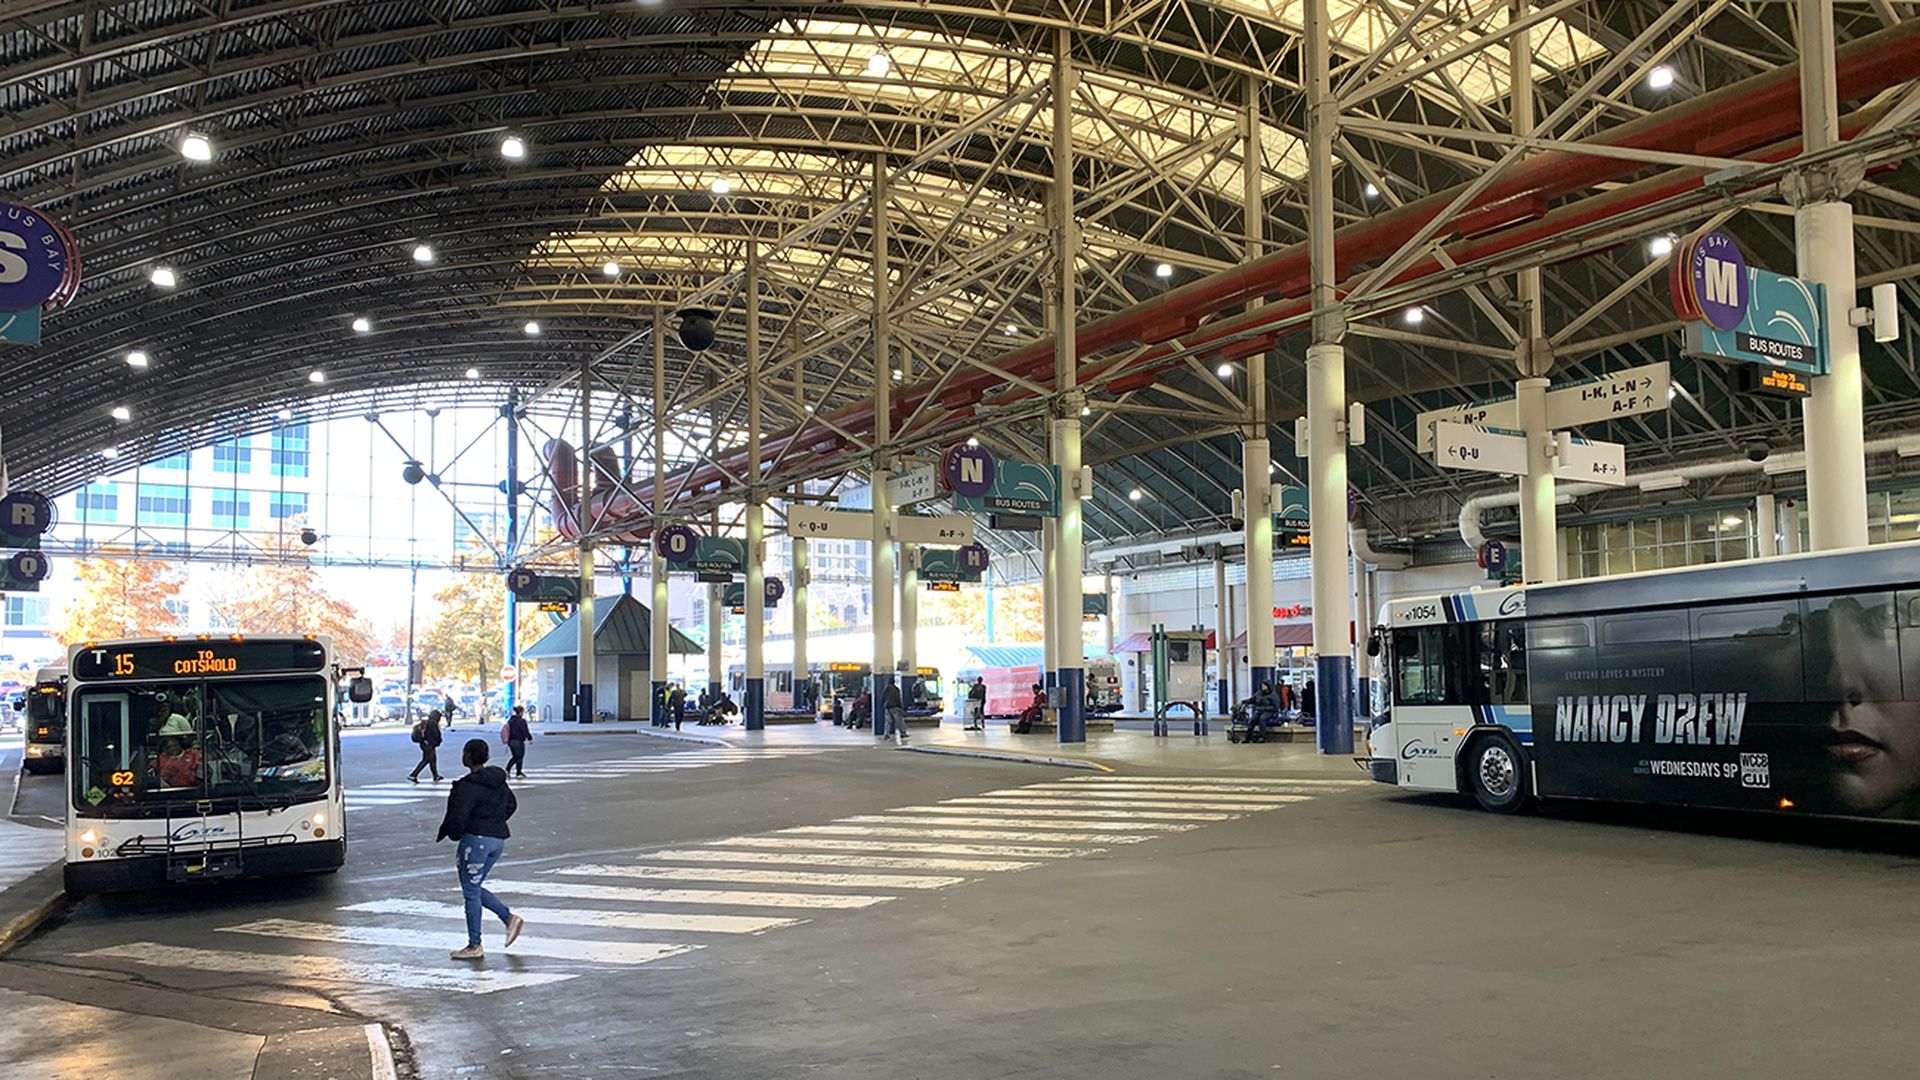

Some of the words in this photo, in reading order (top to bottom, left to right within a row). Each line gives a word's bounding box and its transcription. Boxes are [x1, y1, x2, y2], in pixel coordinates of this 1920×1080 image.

[0, 207, 36, 228] US
[41, 233, 61, 272] BAY
[0, 230, 28, 283] S
[1695, 246, 1707, 279] BUS
[1708, 236, 1729, 249] BAY
[1704, 256, 1739, 308] M
[1749, 337, 1768, 353] BUS
[1768, 341, 1804, 360] ROUTES
[1581, 386, 1608, 401] I-K,
[1611, 379, 1637, 395] L-N
[1612, 396, 1637, 412] A-F
[1464, 410, 1487, 425] N-P
[1459, 446, 1480, 461] Q-U
[960, 456, 984, 483] N
[1592, 462, 1608, 474] A-F
[995, 499, 1011, 507] BUS
[1011, 500, 1041, 509] ROUTES
[11, 503, 36, 525] R
[808, 521, 828, 532] Q-U
[938, 529, 956, 539] A-F
[670, 534, 687, 553] O
[968, 550, 980, 566] H
[1490, 547, 1500, 563] E
[20, 556, 38, 578] Q
[517, 575, 531, 588] P
[766, 583, 777, 596] G
[1412, 605, 1437, 619] 1054
[91, 650, 107, 665] T
[198, 650, 214, 660] TO
[114, 653, 135, 675] 15
[174, 658, 237, 674] COTSWOLD
[1565, 669, 1599, 681] EVERYONE
[1601, 669, 1624, 680] LOVES
[1625, 669, 1631, 679] A
[1631, 667, 1665, 679] MYSTERY
[1554, 694, 1648, 744] NANCY
[1654, 692, 1748, 746] DREW
[1650, 760, 1721, 778] WEDNESDAYS
[1722, 762, 1739, 778] 9P
[111, 771, 134, 786] 62
